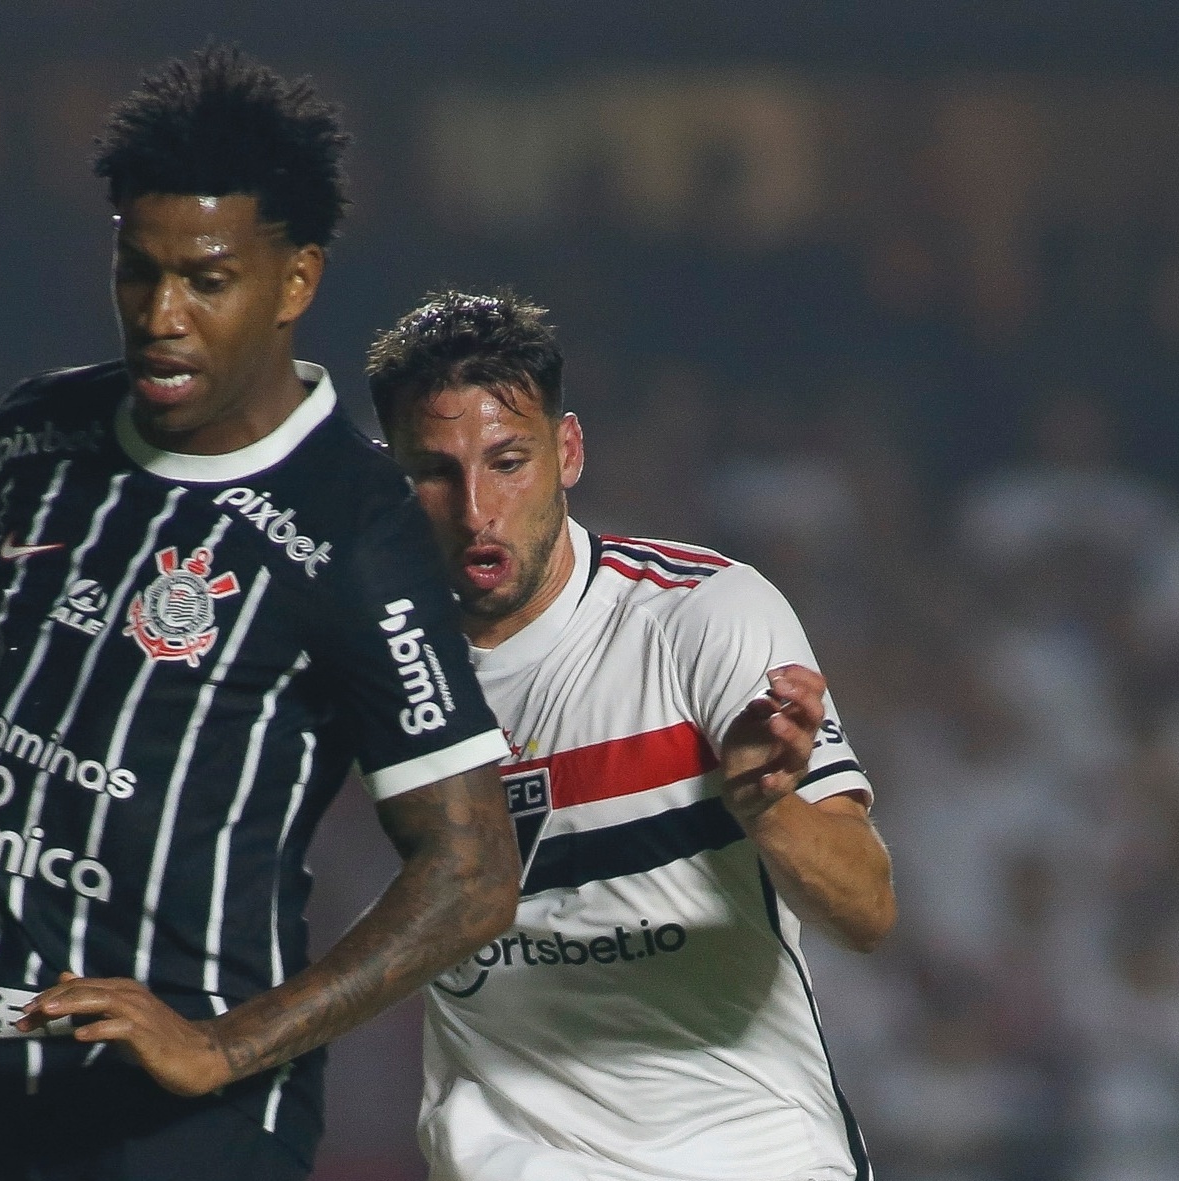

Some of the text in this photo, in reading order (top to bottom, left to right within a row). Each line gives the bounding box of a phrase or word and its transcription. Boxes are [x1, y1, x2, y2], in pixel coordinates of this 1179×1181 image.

[212, 487, 333, 579] pixbet
[387, 628, 448, 735] bmg
[472, 918, 687, 967] ortsbet.io
